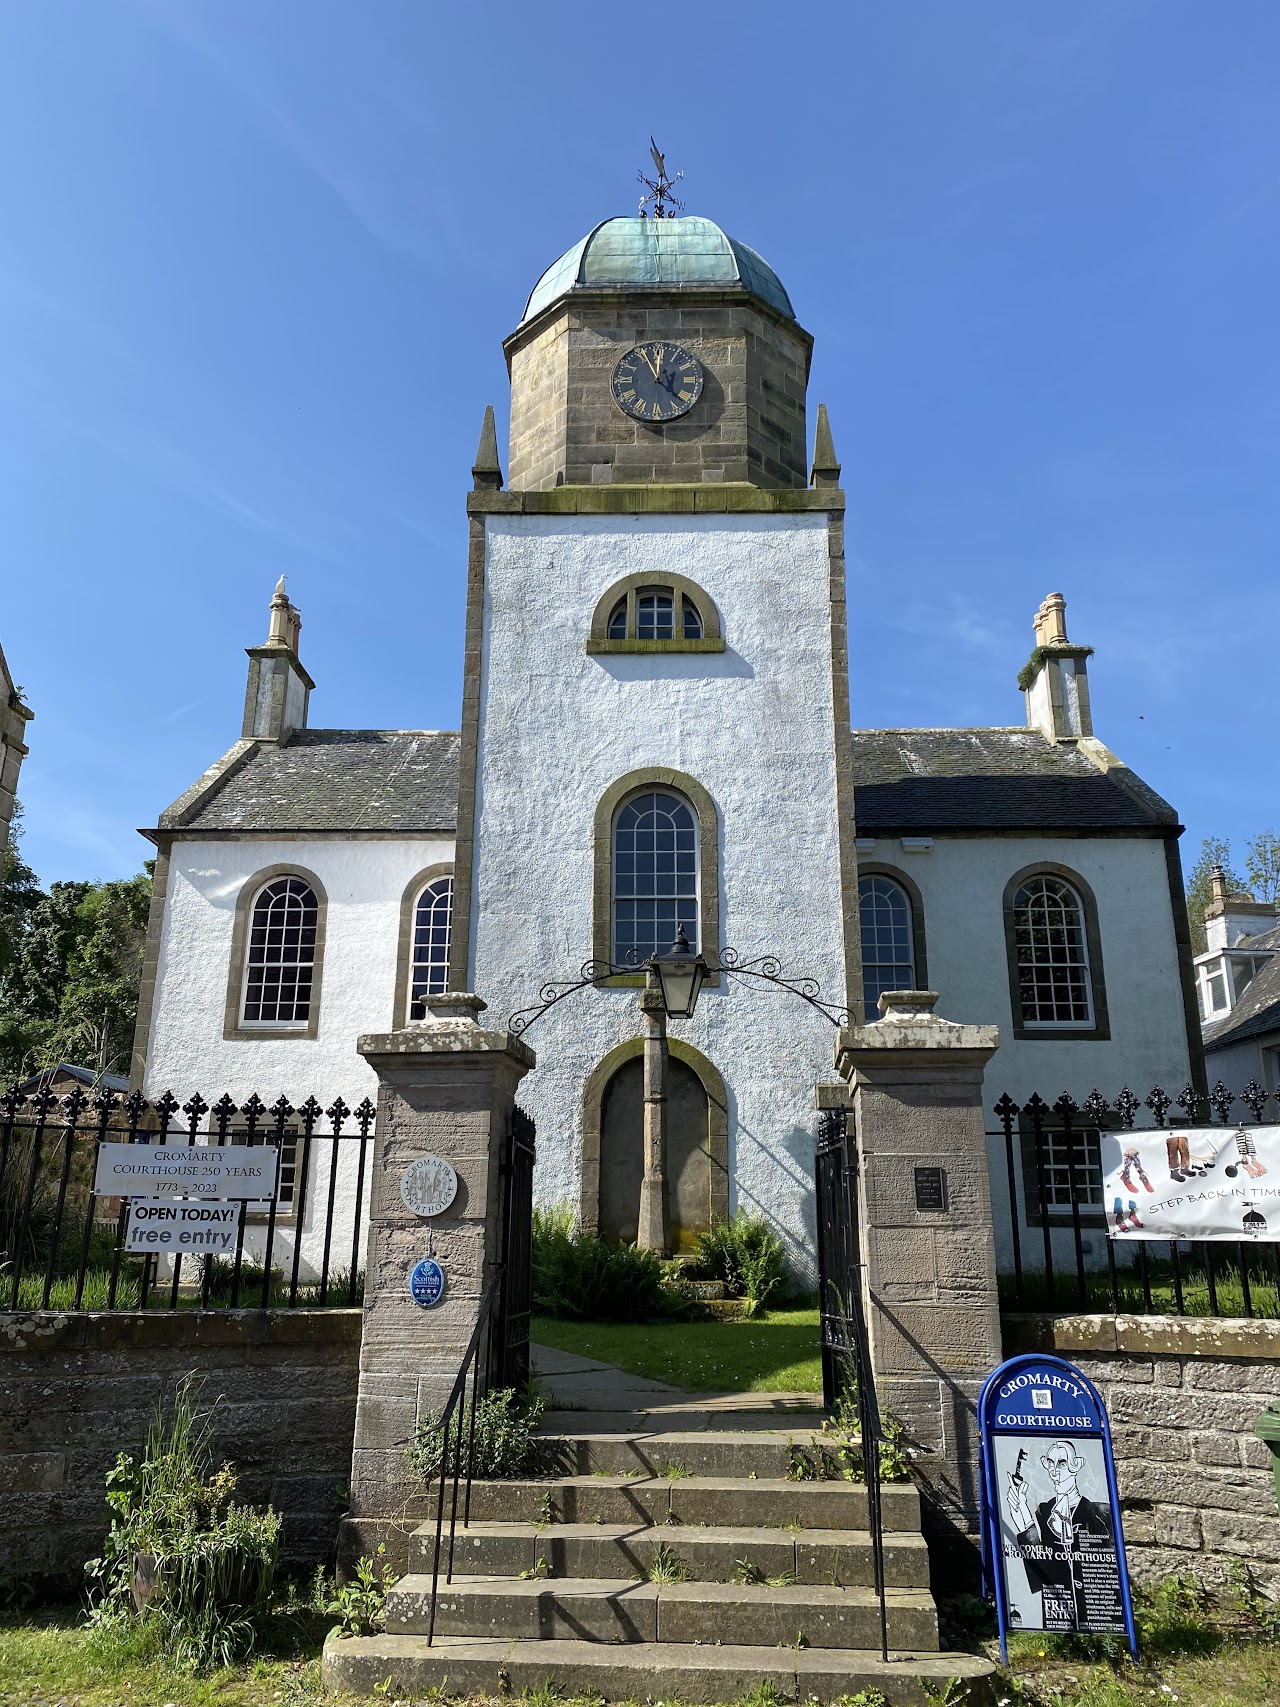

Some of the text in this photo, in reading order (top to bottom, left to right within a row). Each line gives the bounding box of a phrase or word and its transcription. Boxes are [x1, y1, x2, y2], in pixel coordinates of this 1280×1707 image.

[154, 1151, 226, 1162] CROMARTY
[113, 1165, 262, 1177] COURTHOUSE 250 YEARS
[406, 1159, 452, 1178] CROMARTY
[155, 1182, 178, 1192] 1773
[192, 1184, 217, 1192] 2023
[404, 1186, 454, 1213] COURTHOUSE
[1149, 1197, 1184, 1214] STEP
[1188, 1190, 1227, 1203] BACK
[1231, 1188, 1246, 1197] IN
[135, 1206, 234, 1222] OPEN TODAY!
[132, 1227, 232, 1248] free entry
[1000, 1373, 1084, 1398] CROMARTY
[998, 1414, 1092, 1428] COURTHOUSE
[1004, 1544, 1053, 1554] WELCOME to
[1003, 1550, 1117, 1562] CROMARTY COURTHOUSE
[1044, 1600, 1074, 1611] FREE
[1046, 1611, 1075, 1619] ENTRY
